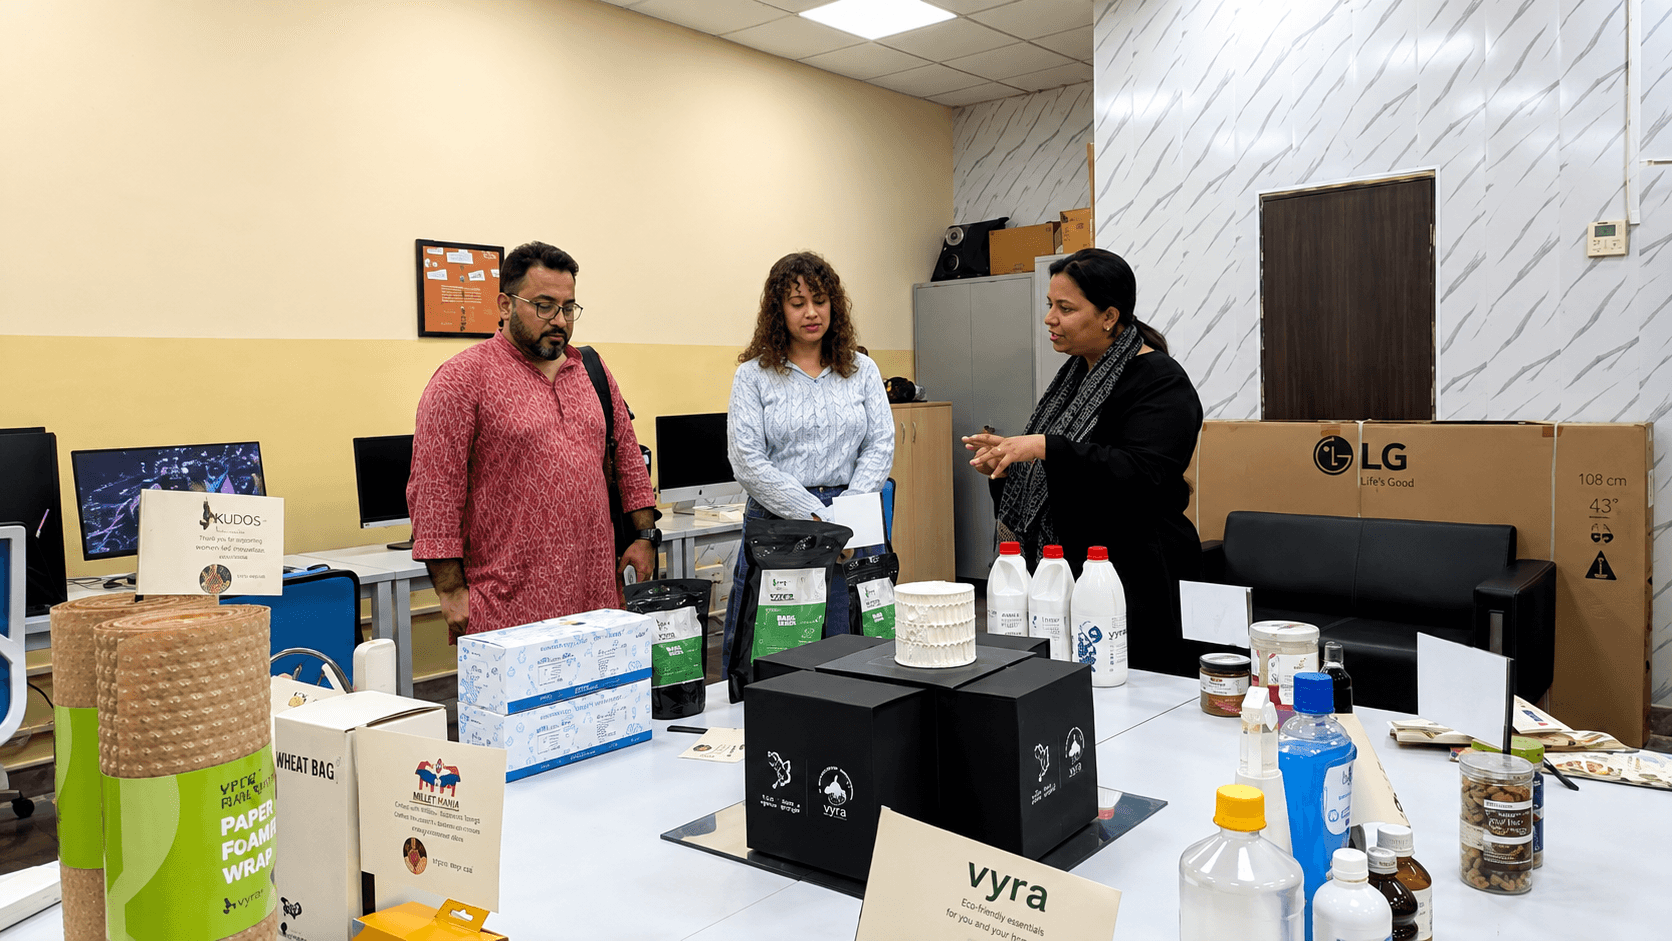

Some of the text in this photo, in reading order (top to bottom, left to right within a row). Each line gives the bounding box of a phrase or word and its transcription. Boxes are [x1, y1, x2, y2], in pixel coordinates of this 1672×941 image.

[1361, 442, 1407, 471] LG
[1360, 476, 1415, 488] Life's Good
[1578, 473, 1627, 486] 108 cm
[215, 513, 261, 527] KUDOS
[276, 751, 335, 780] WHEAT BAG
[221, 798, 273, 836] PAPER
[823, 804, 847, 818] vyra
[222, 847, 272, 884] WRAP
[968, 861, 1048, 913] vyra
[945, 907, 958, 919] for
[958, 914, 973, 925] you
[974, 921, 990, 932] and
[990, 927, 1010, 938] your
[960, 897, 1045, 937] Eco-friendly essentials
